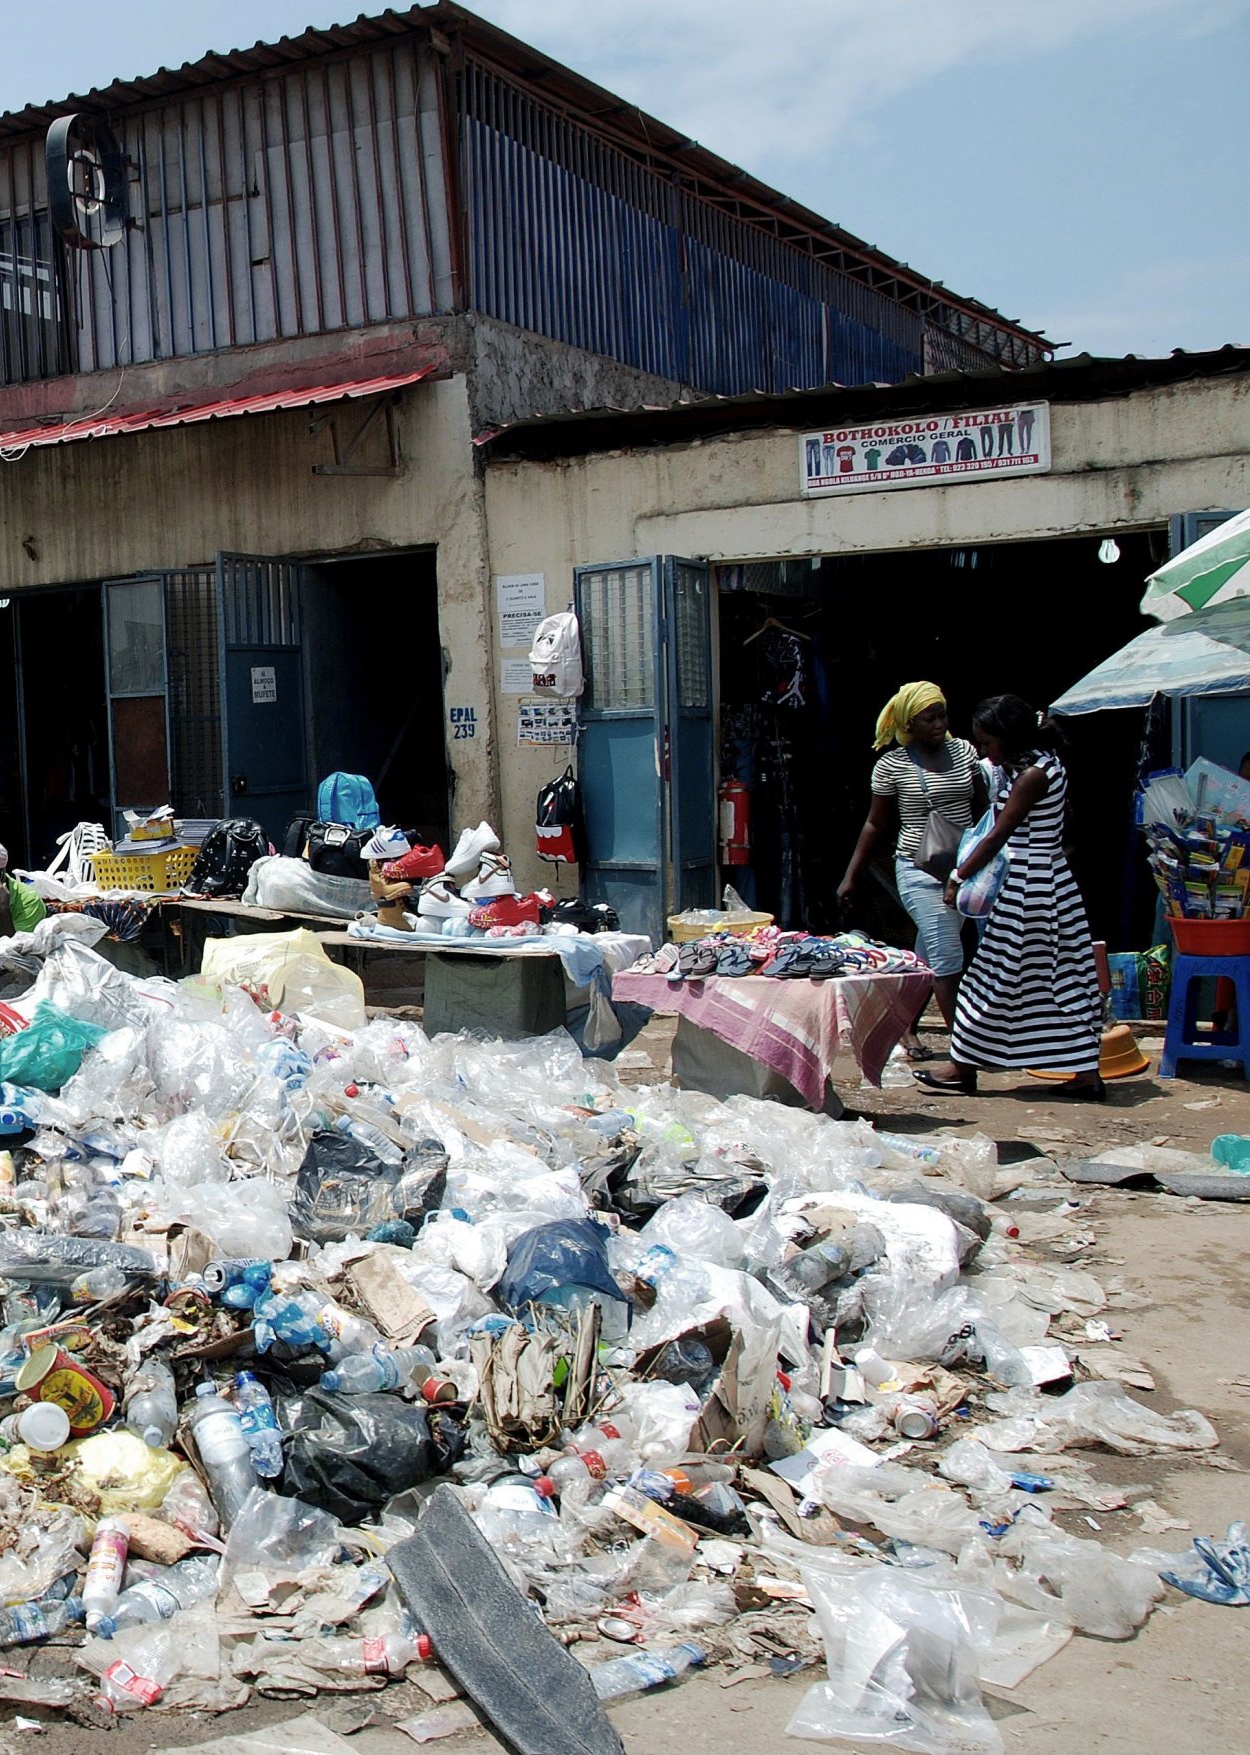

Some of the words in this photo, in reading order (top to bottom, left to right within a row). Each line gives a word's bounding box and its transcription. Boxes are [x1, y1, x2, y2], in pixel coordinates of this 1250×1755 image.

[823, 420, 939, 444] BOTHOKOLO
[952, 411, 1015, 429] FILIAL
[929, 429, 972, 441] GERAL
[502, 611, 542, 619] PRECISA-SE
[254, 689, 276, 699] MUFETE
[450, 707, 478, 723] EPAL
[454, 723, 475, 739] 239
